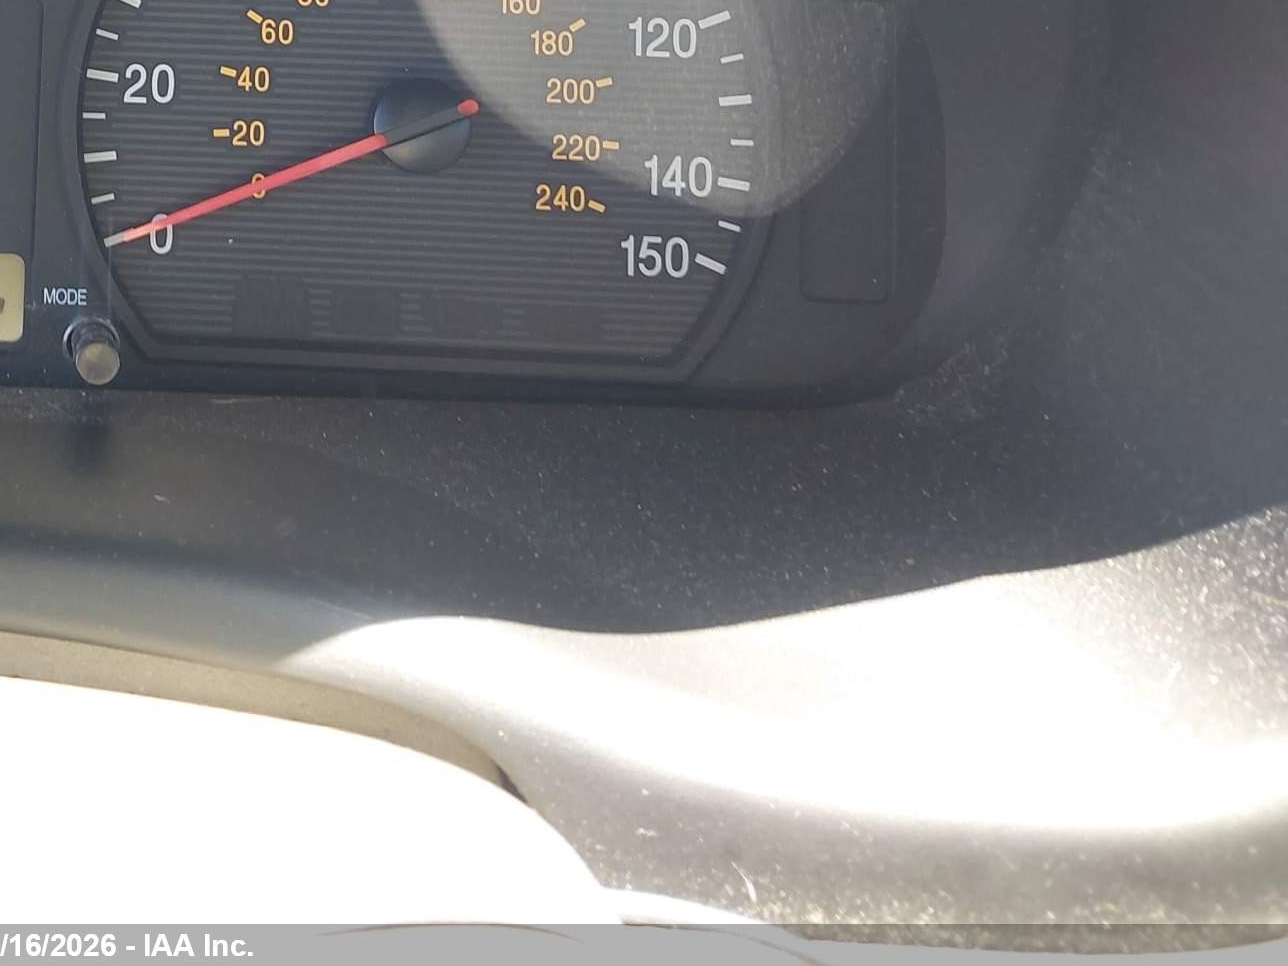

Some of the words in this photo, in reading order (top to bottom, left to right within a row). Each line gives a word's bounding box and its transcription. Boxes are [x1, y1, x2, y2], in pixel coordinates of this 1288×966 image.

[261, 19, 295, 45] 60
[531, 30, 574, 56] 180
[629, 17, 698, 59] 120
[123, 63, 174, 104] 20
[237, 66, 271, 93] 40
[546, 79, 595, 105] 200
[231, 121, 265, 147] 20
[552, 135, 600, 161] 220
[644, 156, 713, 197] 140
[535, 185, 585, 211] 240
[620, 235, 689, 278] 150
[44, 288, 88, 306] MODE
